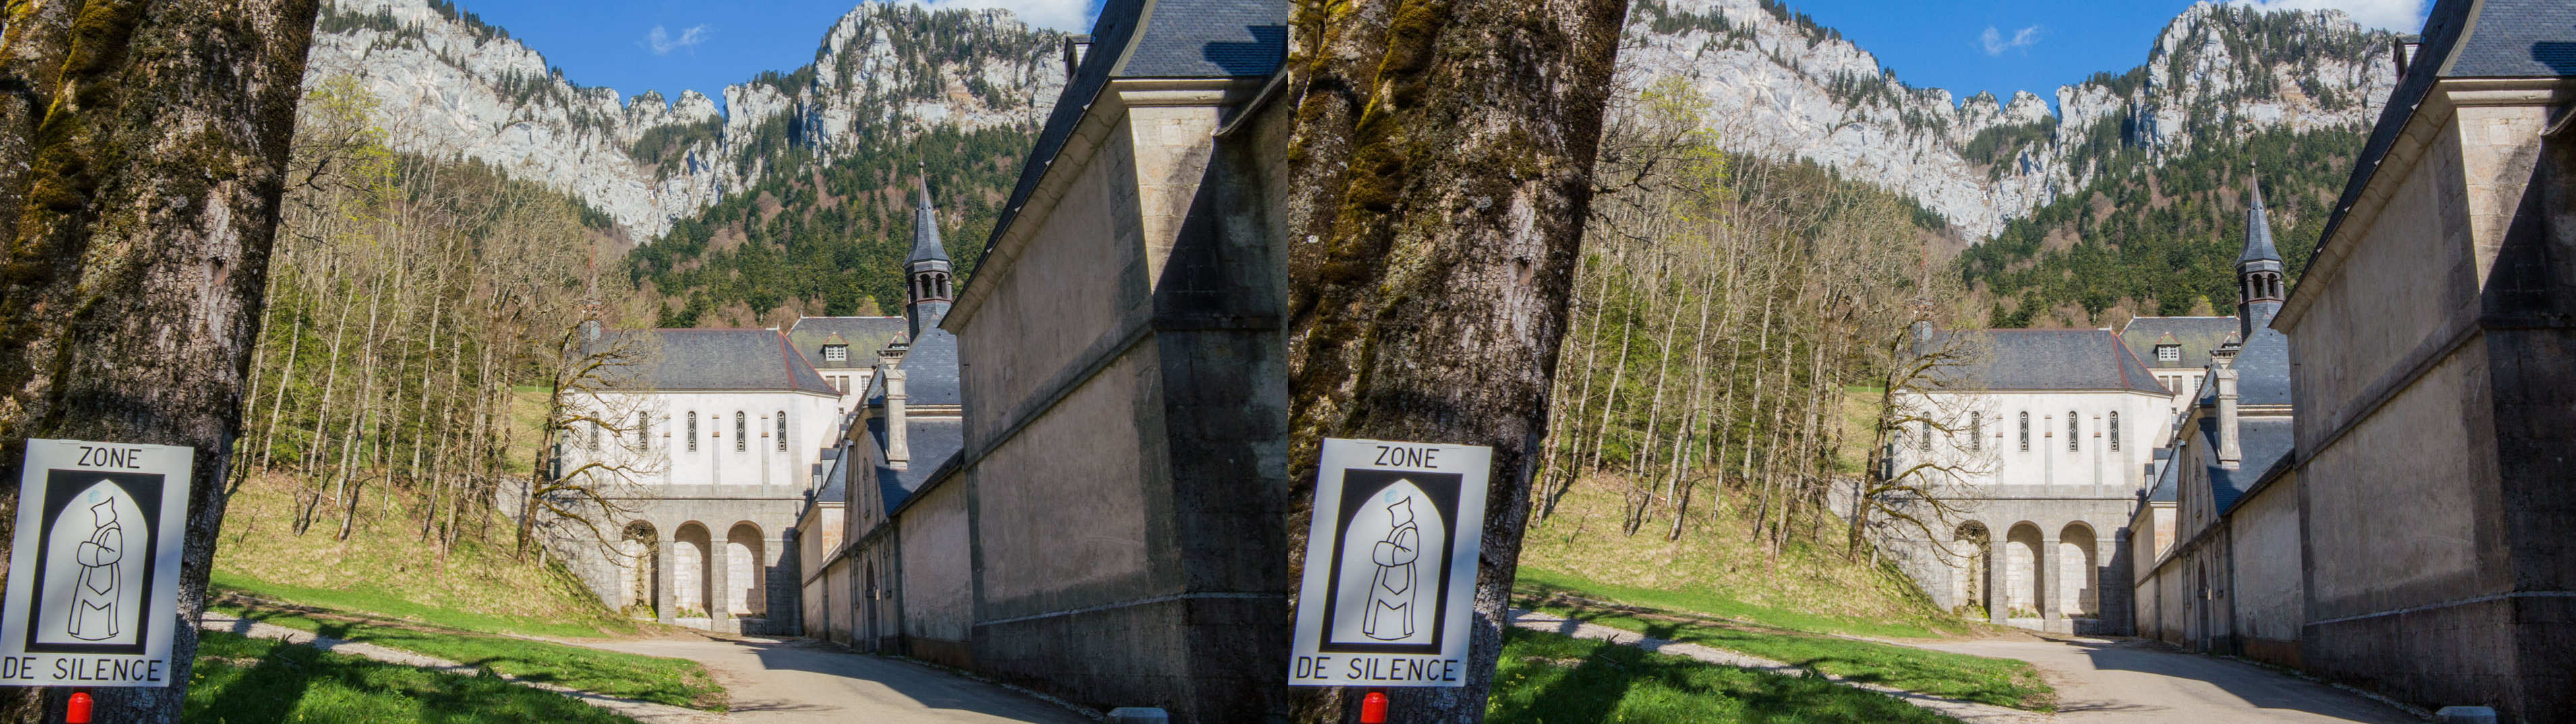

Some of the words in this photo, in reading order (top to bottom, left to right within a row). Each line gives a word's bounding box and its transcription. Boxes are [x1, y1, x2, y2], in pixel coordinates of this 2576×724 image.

[78, 446, 142, 469] ZONE
[1374, 446, 1440, 469] ZONE
[3, 656, 36, 680] DE
[53, 657, 163, 682] SILENCE
[1295, 656, 1330, 680] DE
[1347, 657, 1458, 682] SILENCE
